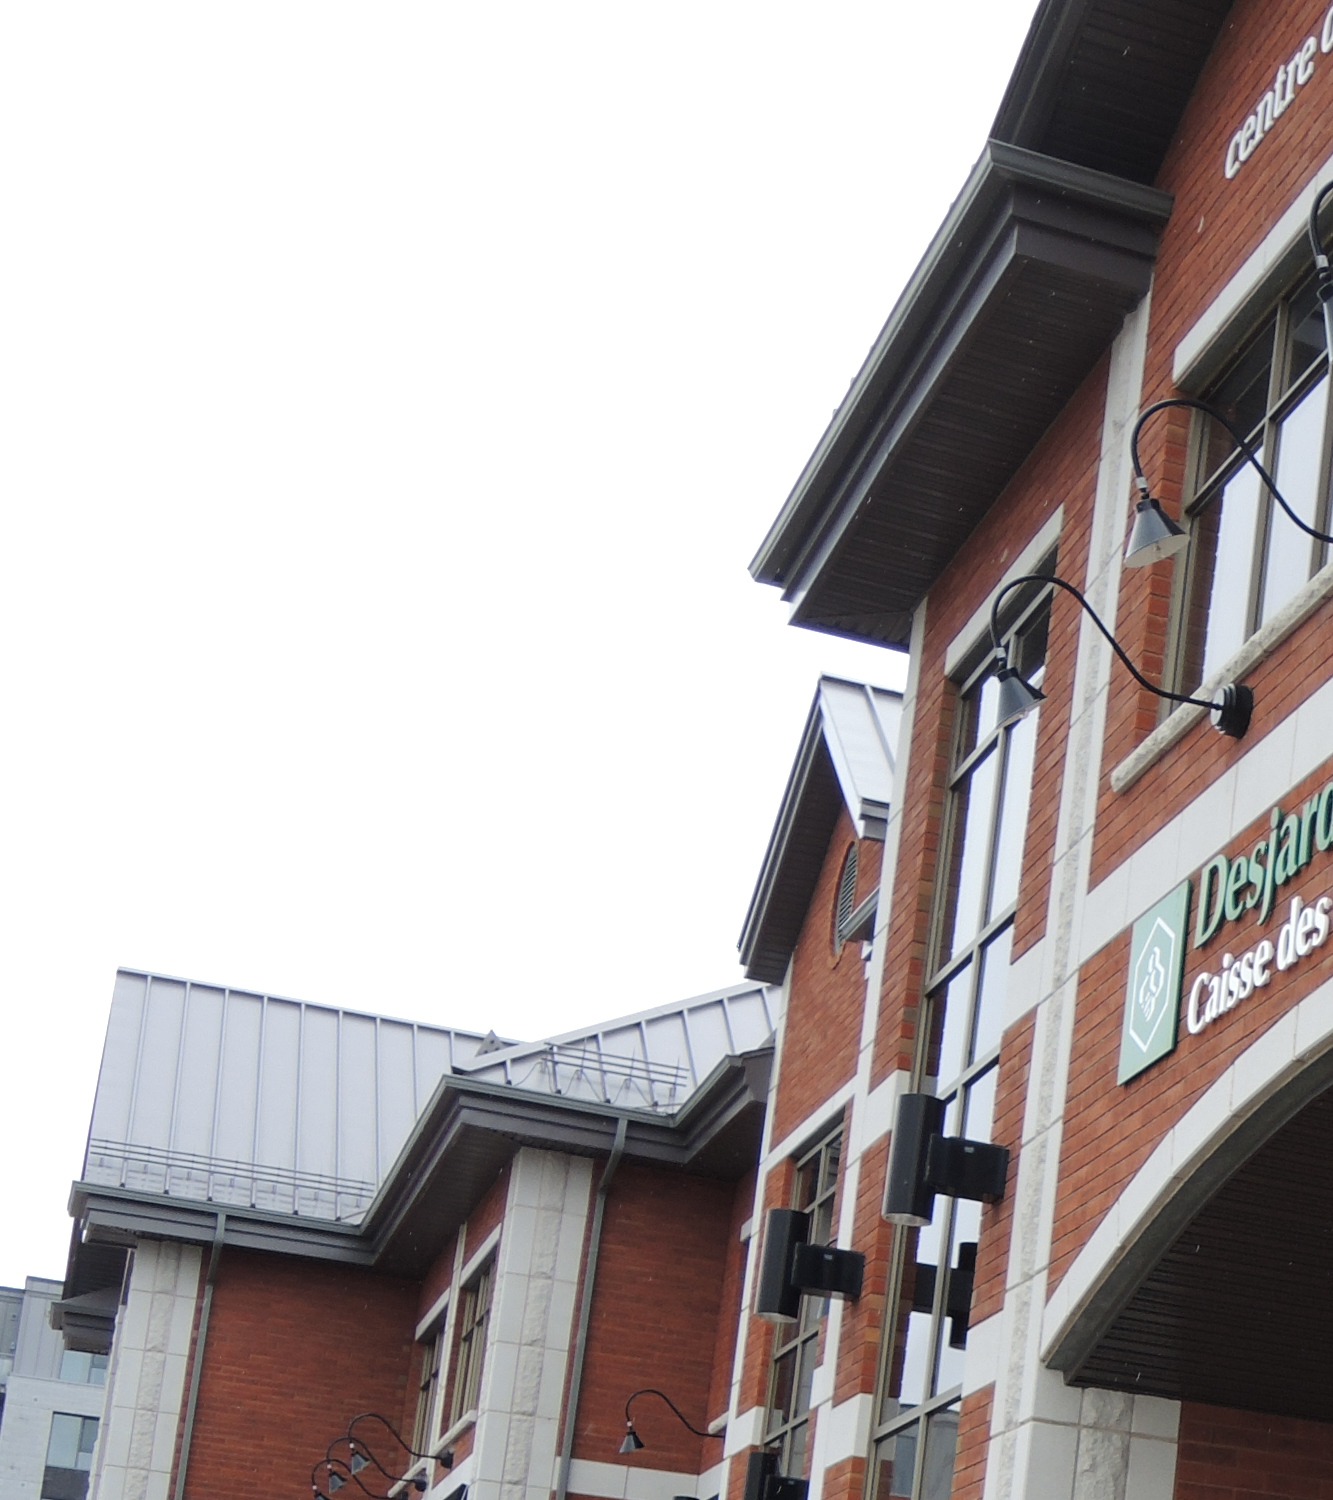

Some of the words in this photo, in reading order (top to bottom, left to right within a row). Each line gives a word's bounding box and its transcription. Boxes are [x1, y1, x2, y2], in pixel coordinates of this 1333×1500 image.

[1225, 36, 1317, 179] centre
[1186, 940, 1272, 1035] Caisse
[1276, 896, 1331, 971] des
